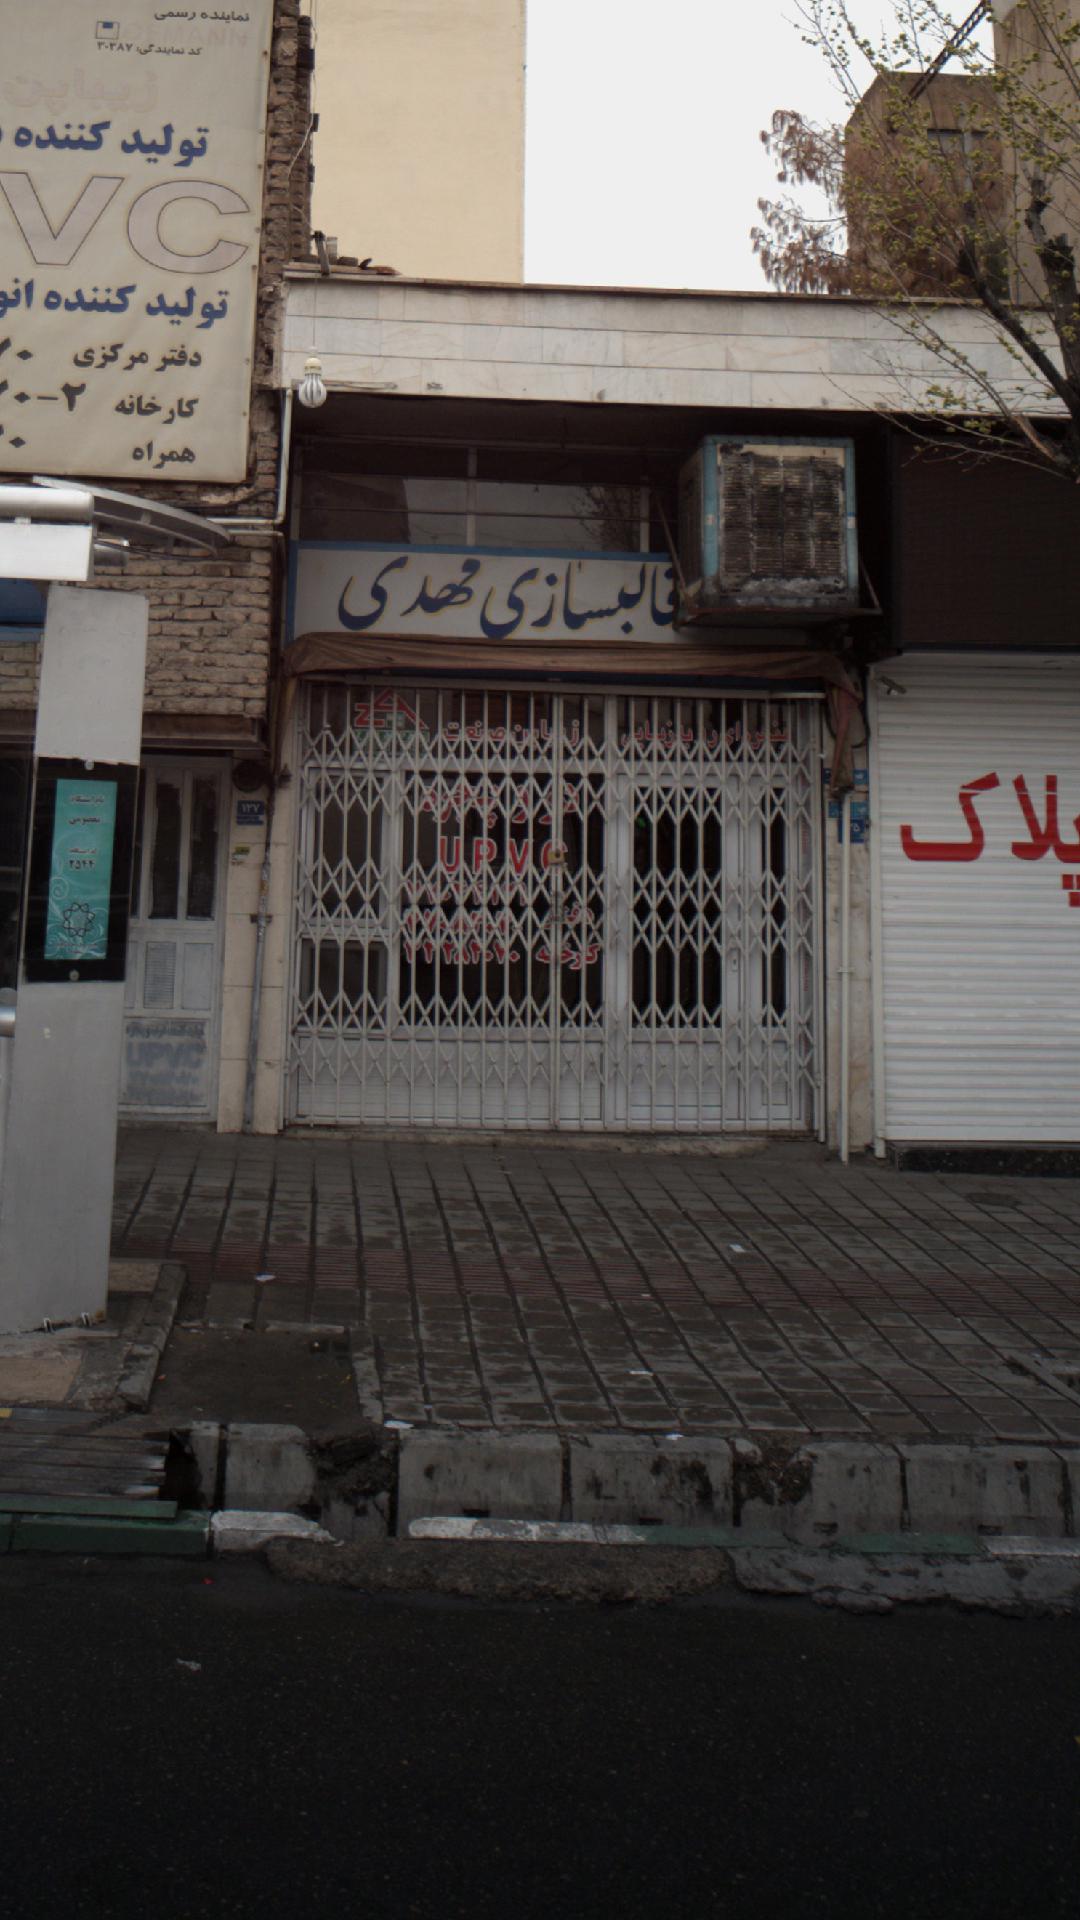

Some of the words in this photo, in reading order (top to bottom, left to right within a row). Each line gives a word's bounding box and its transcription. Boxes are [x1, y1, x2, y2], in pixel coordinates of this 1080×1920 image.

[154, 9, 196, 22] رسمی
[200, 10, 250, 23] نماینده
[187, 46, 202, 56] کد
[14, 120, 111, 151] کننده
[121, 123, 210, 167] تولید
[43, 283, 137, 314] کننده
[146, 286, 230, 329] تولید
[73, 342, 149, 371] مرکزی
[155, 344, 202, 372] دفتر
[114, 394, 200, 425] کارخانه
[132, 440, 196, 470] همراه
[337, 555, 482, 632] مهدی
[438, 834, 569, 876] UPVC
